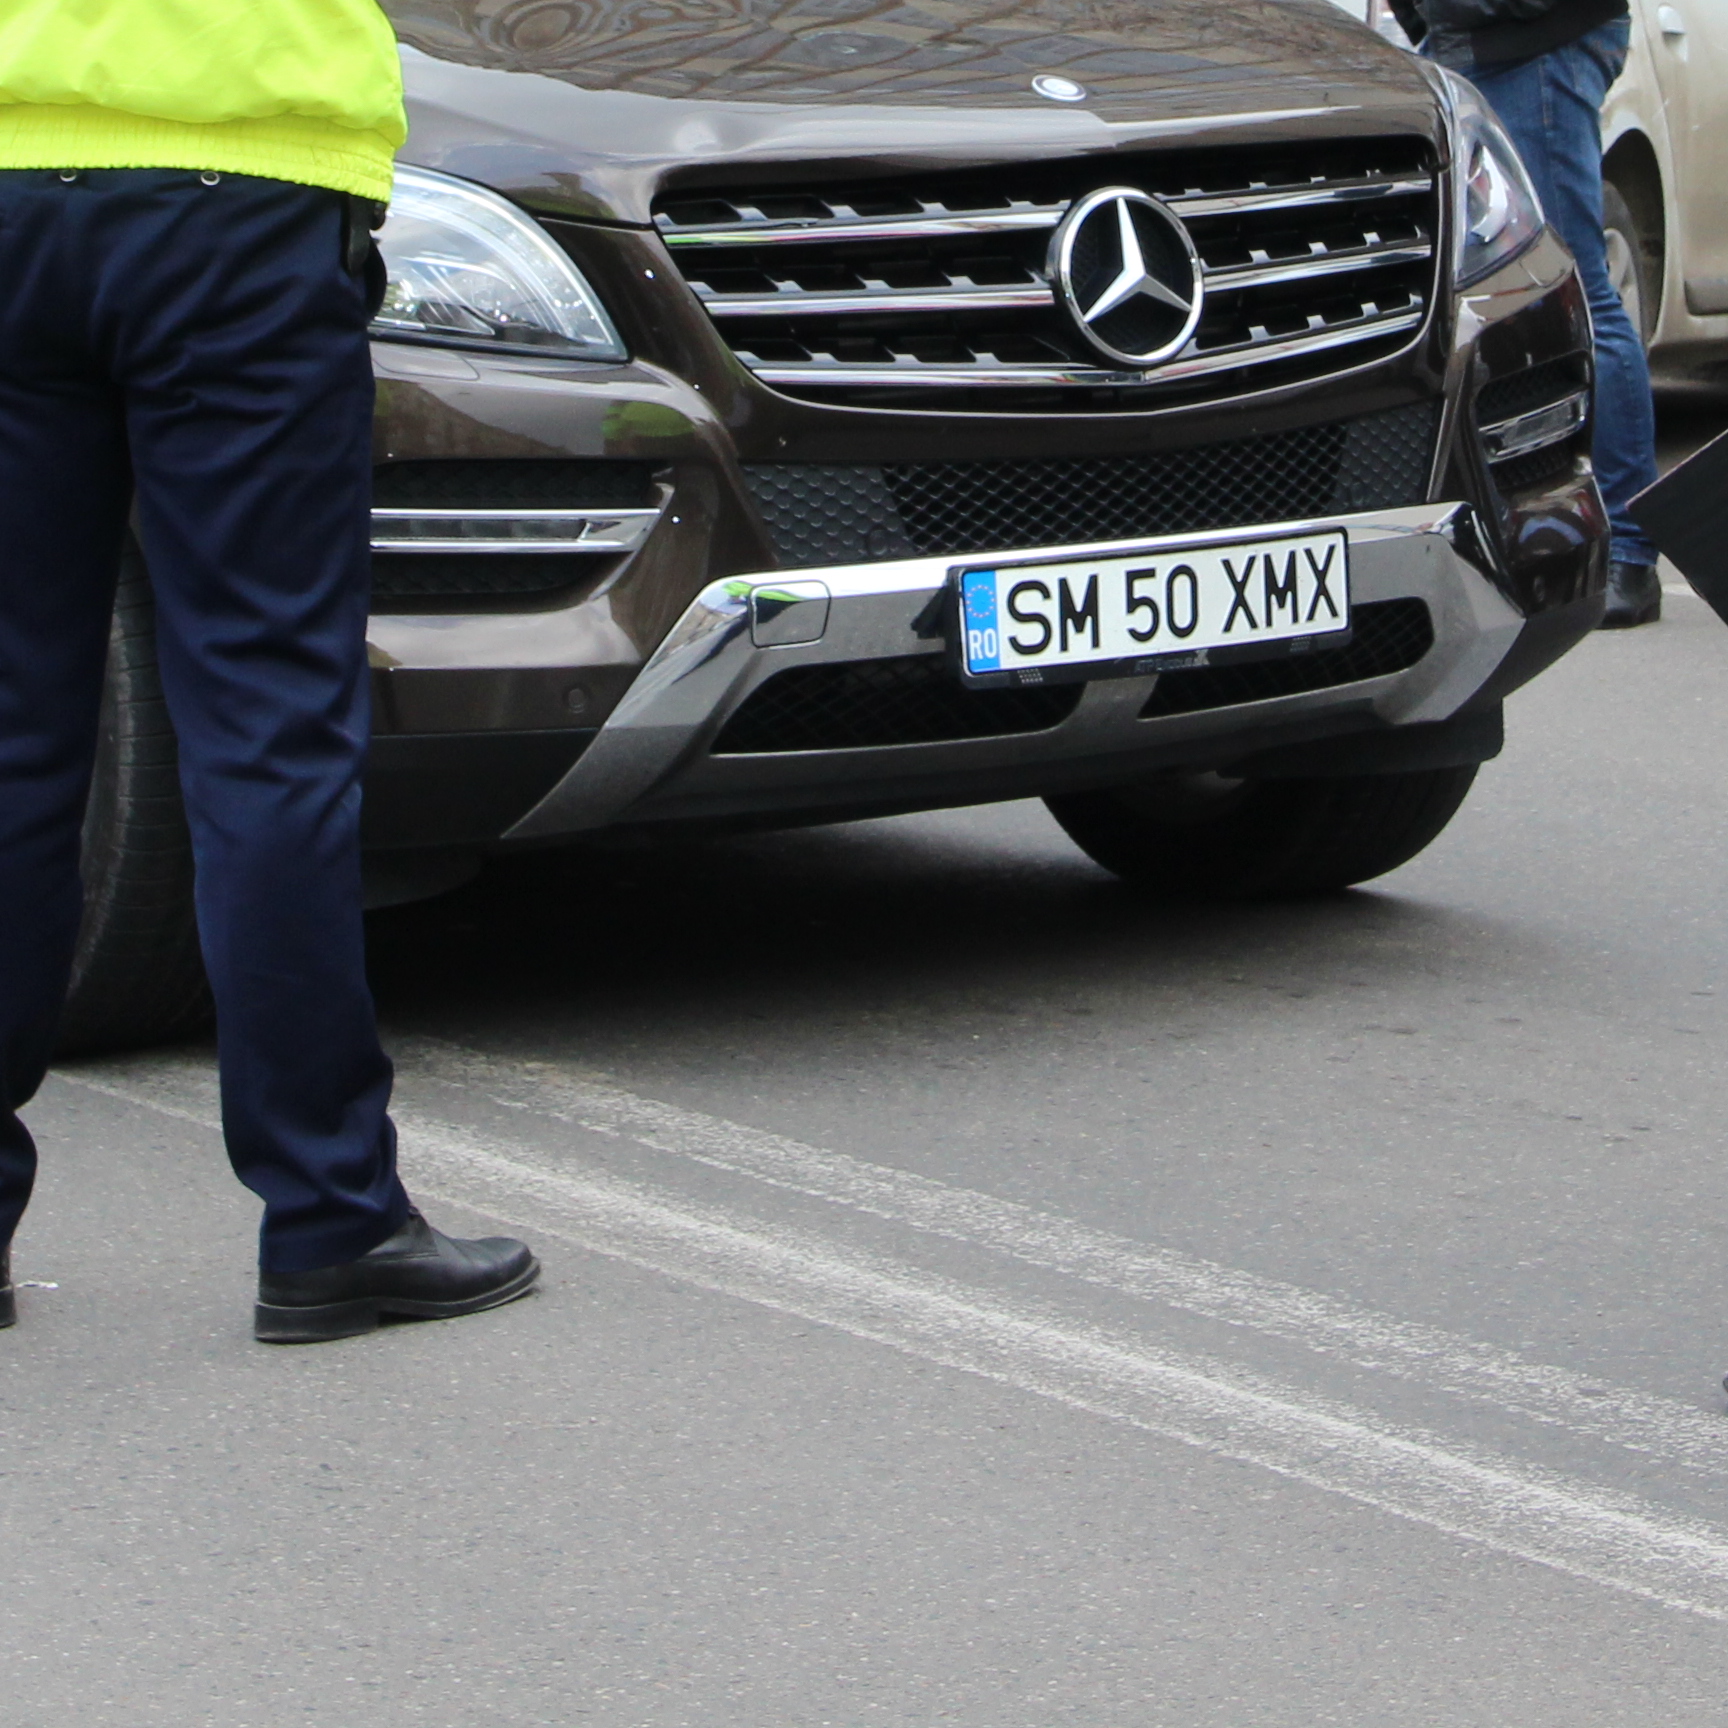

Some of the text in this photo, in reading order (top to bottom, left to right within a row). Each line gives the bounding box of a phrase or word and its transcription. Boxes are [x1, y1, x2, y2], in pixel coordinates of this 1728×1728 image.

[1006, 544, 1340, 656] SM 50 XMX
[968, 628, 998, 661] RO
